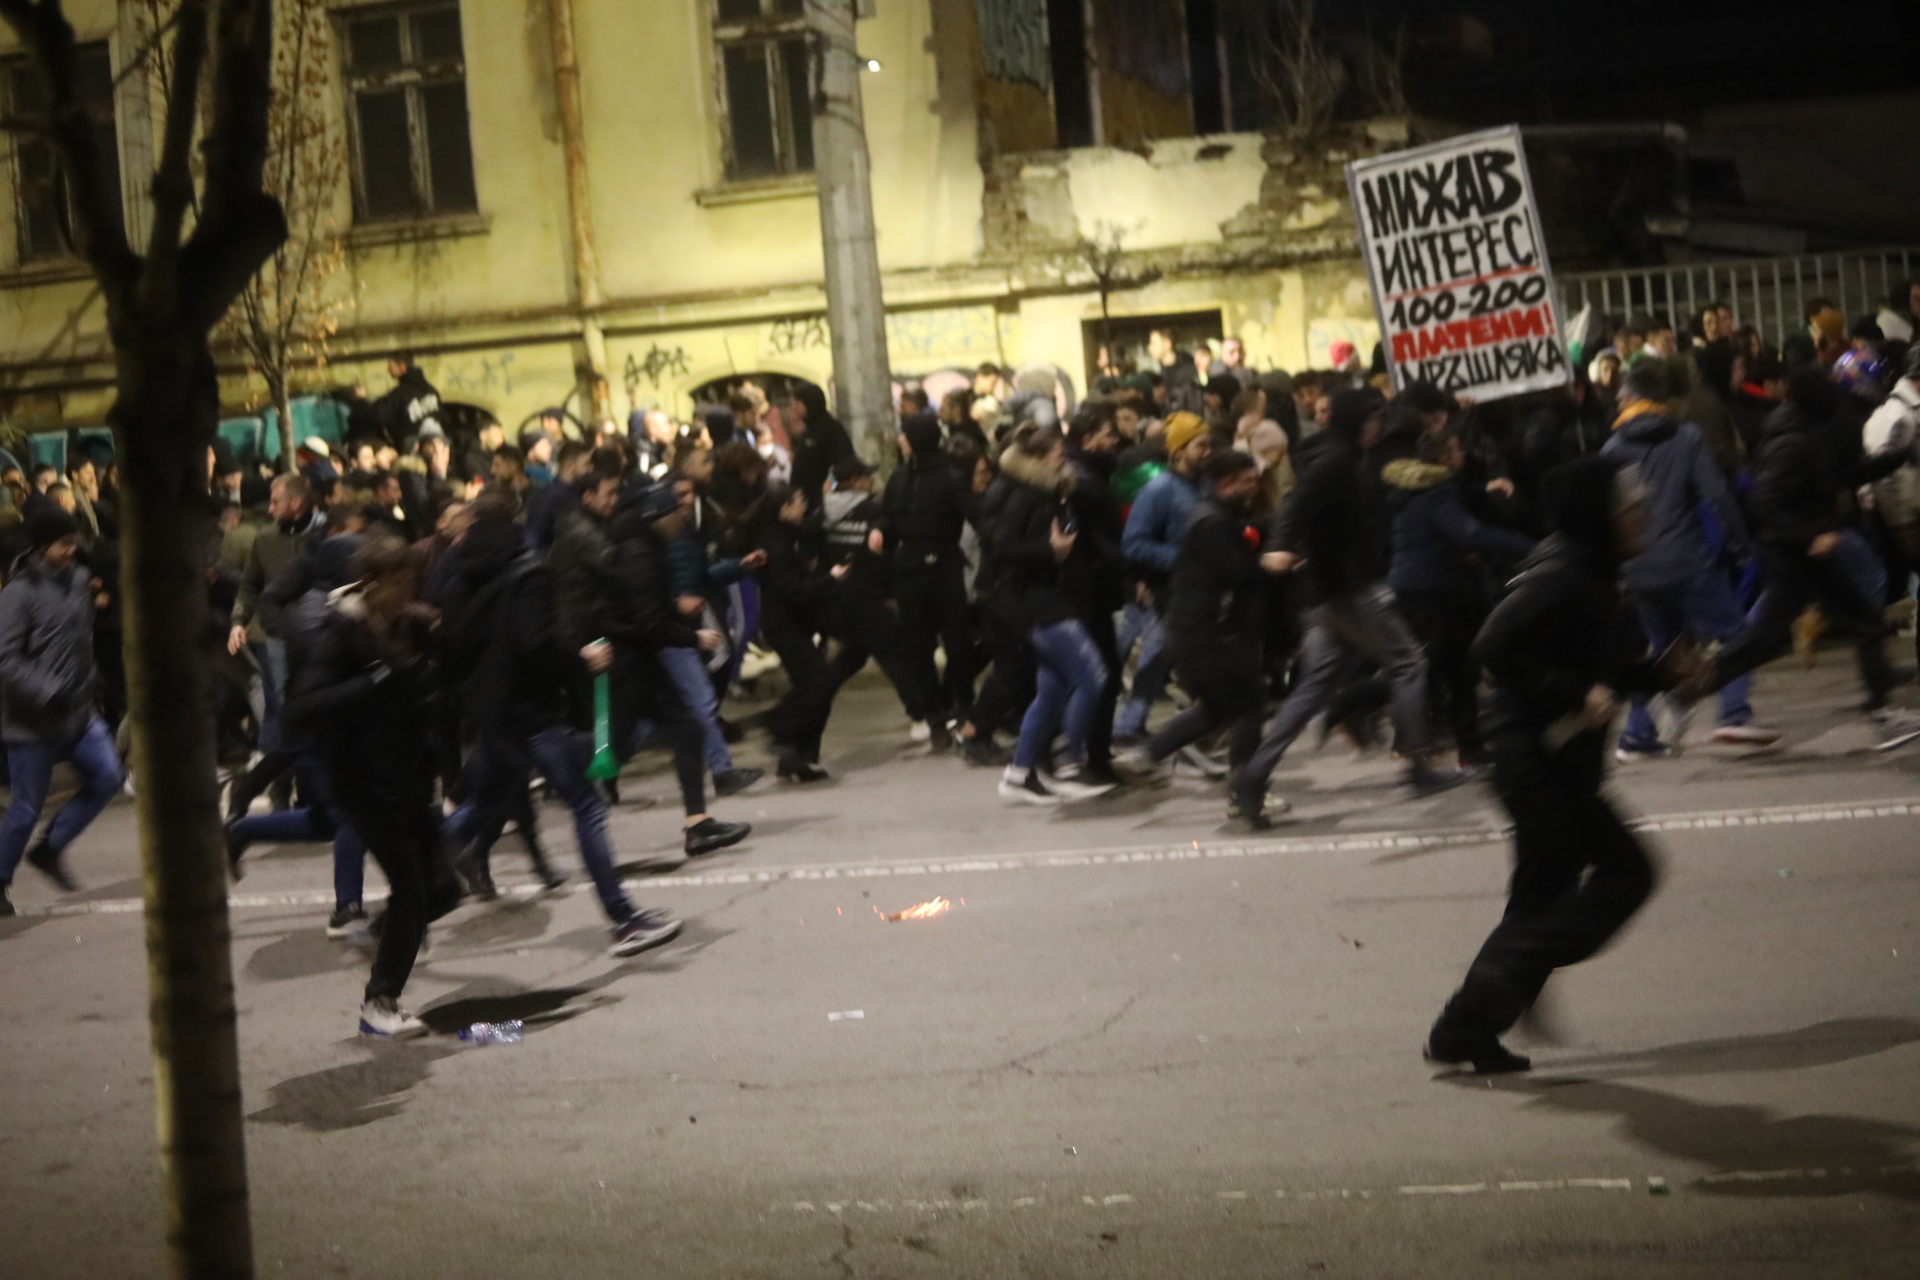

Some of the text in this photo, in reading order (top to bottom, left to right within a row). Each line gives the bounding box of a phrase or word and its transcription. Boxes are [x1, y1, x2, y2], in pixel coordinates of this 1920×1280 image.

[1362, 149, 1523, 240] МИЖАВ
[1390, 275, 1547, 330] 100-200
[1391, 302, 1556, 363] ПЛАТЕНИ!
